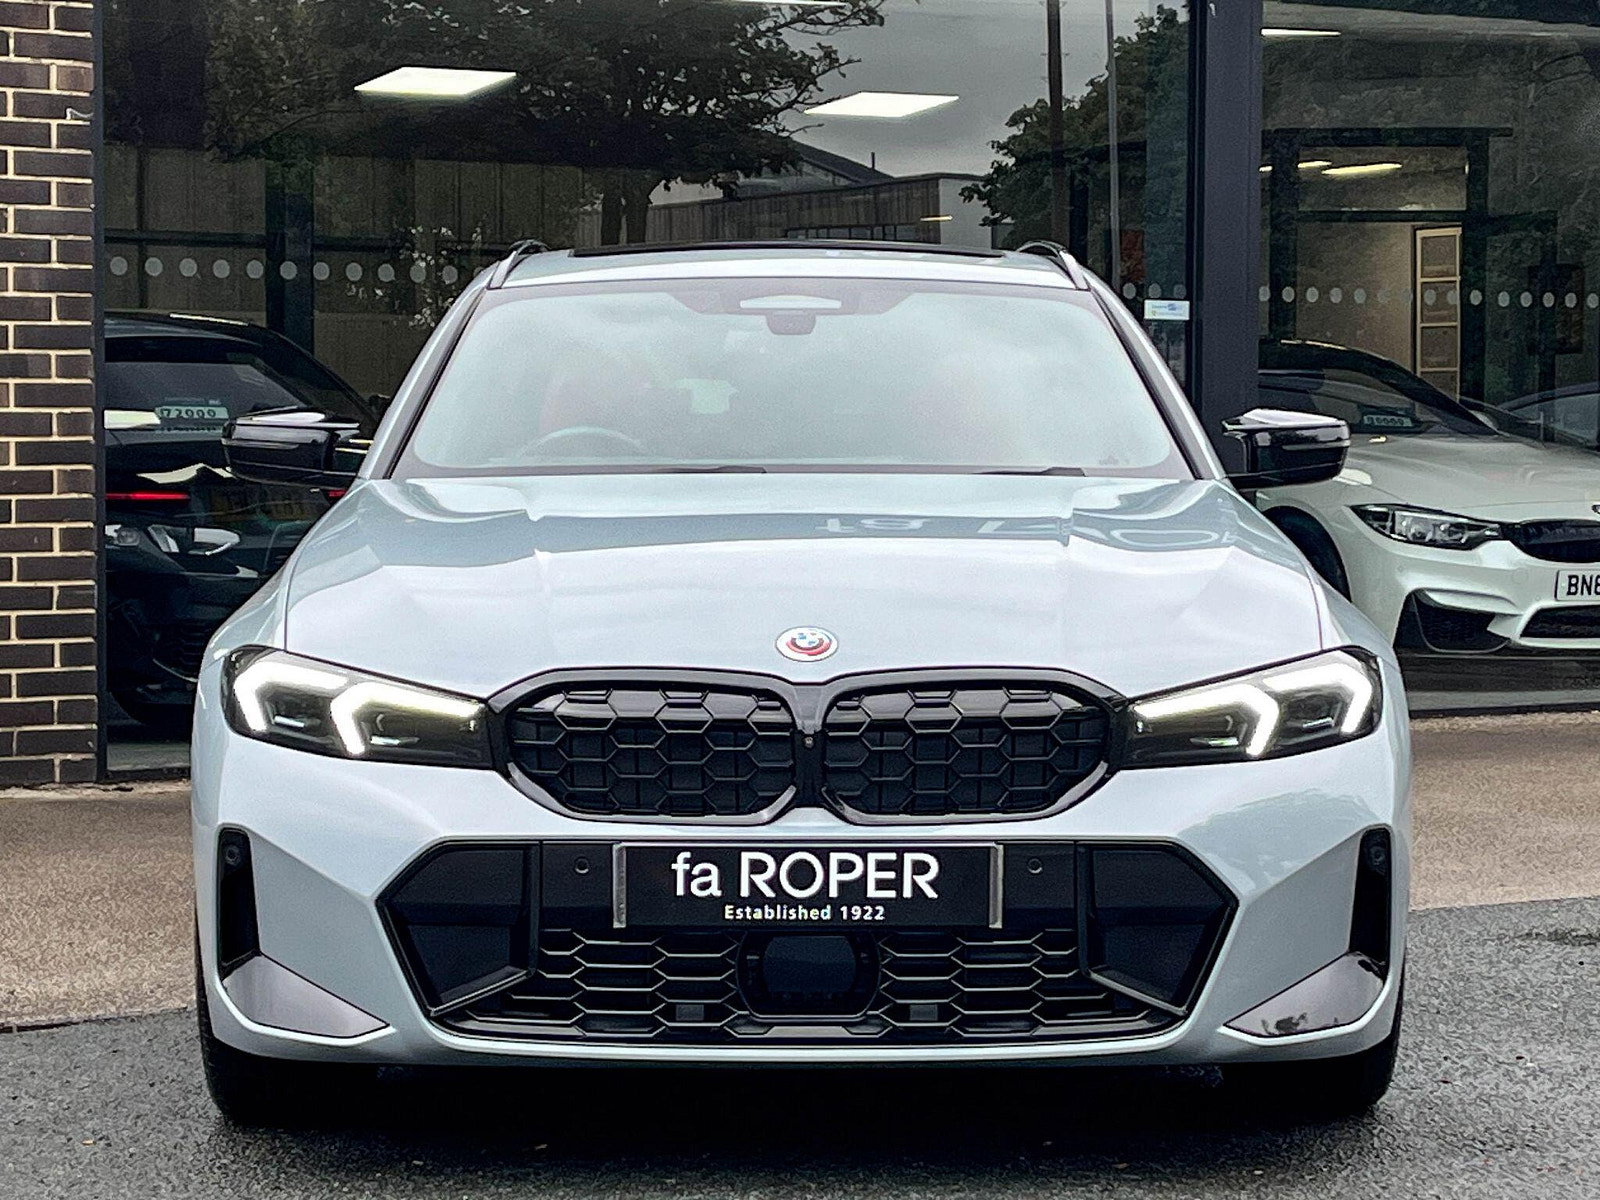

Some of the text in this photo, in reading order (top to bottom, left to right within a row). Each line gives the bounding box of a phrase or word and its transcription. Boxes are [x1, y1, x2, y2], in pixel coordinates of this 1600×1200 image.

[672, 852, 939, 899] fa ROPER
[724, 904, 885, 920] Established 1922
